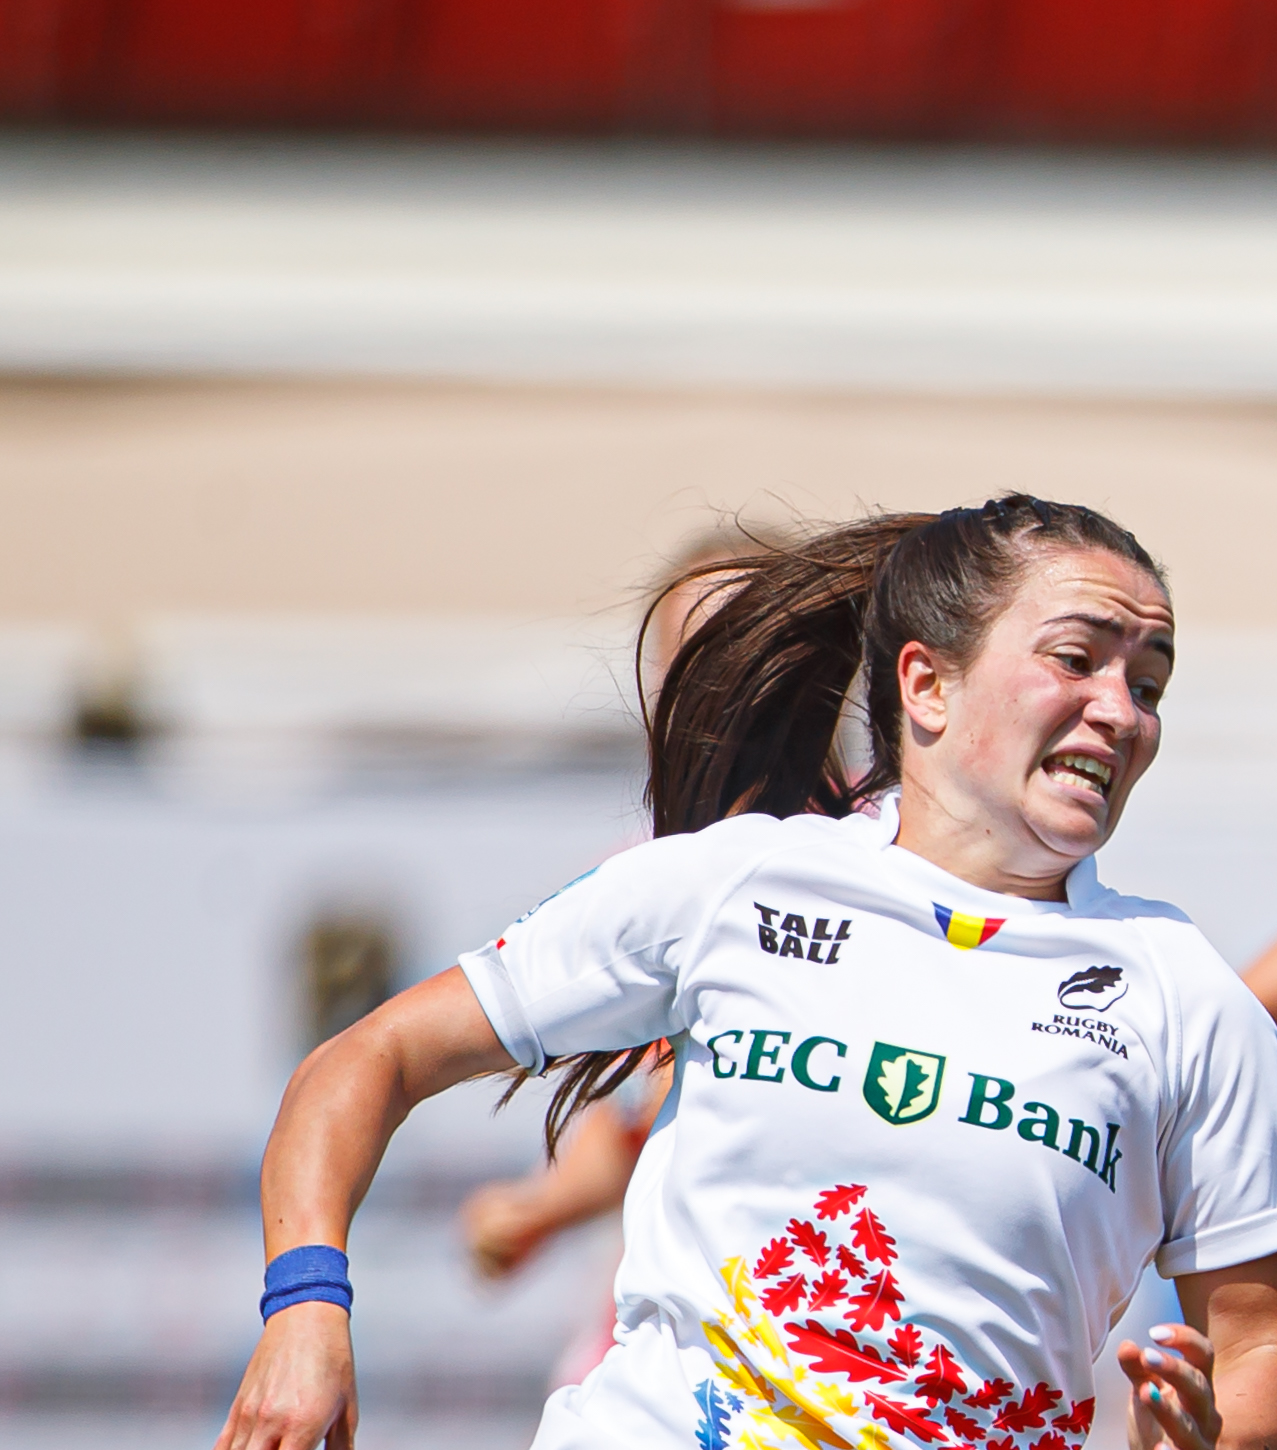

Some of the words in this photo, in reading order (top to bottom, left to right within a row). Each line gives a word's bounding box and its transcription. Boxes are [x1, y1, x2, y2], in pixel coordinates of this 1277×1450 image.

[753, 901, 853, 941] TALL
[758, 923, 842, 965] BALL
[1031, 1022, 1129, 1060] ROMANIA
[1053, 1014, 1119, 1037] RUGBY
[707, 1029, 848, 1092] CEC
[957, 1072, 1123, 1194] Bank
